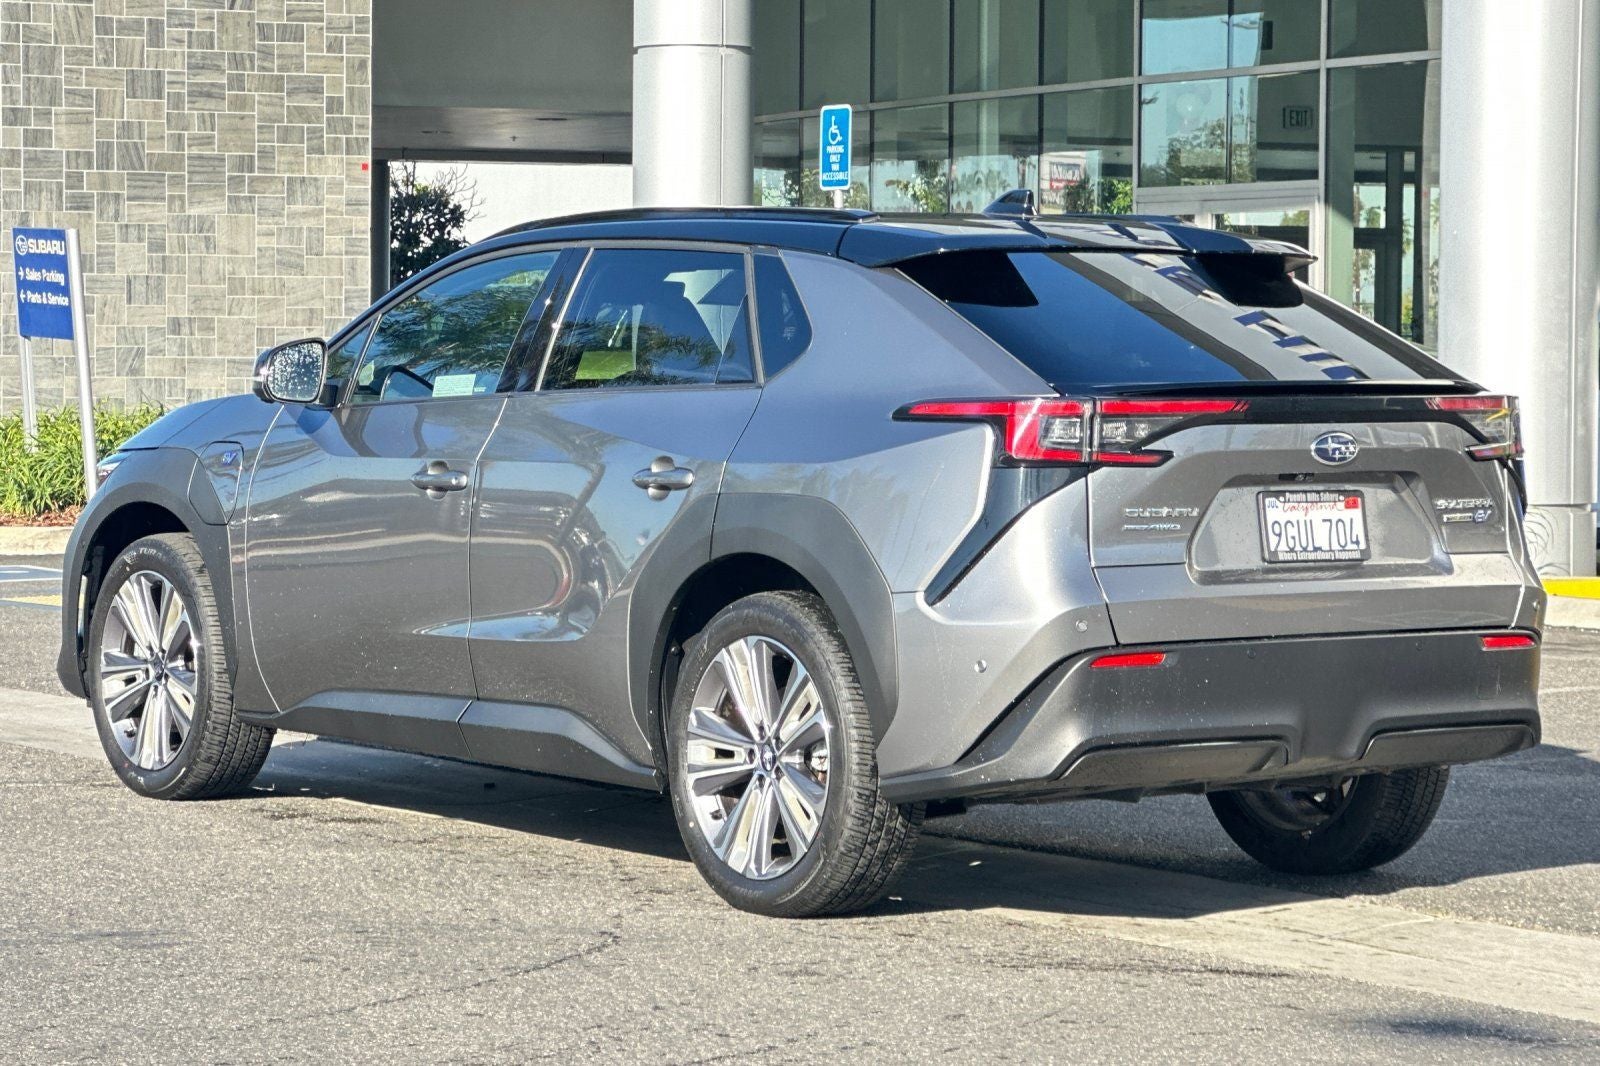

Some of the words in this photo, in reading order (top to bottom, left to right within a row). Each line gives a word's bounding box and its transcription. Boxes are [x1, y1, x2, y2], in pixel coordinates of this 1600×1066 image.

[1290, 110, 1308, 127] EXIT
[826, 145, 845, 154] PARKING
[829, 153, 841, 163] ONLY
[822, 171, 848, 181] ACCESSIBLE
[27, 238, 65, 256] SUBARU
[25, 267, 41, 281] Sales
[42, 269, 65, 286] Parking
[26, 290, 42, 304] Parts
[42, 292, 48, 304] &
[48, 292, 69, 306] Service
[1125, 507, 1199, 517] SUBARU
[1271, 518, 1361, 552] 9GUL704
